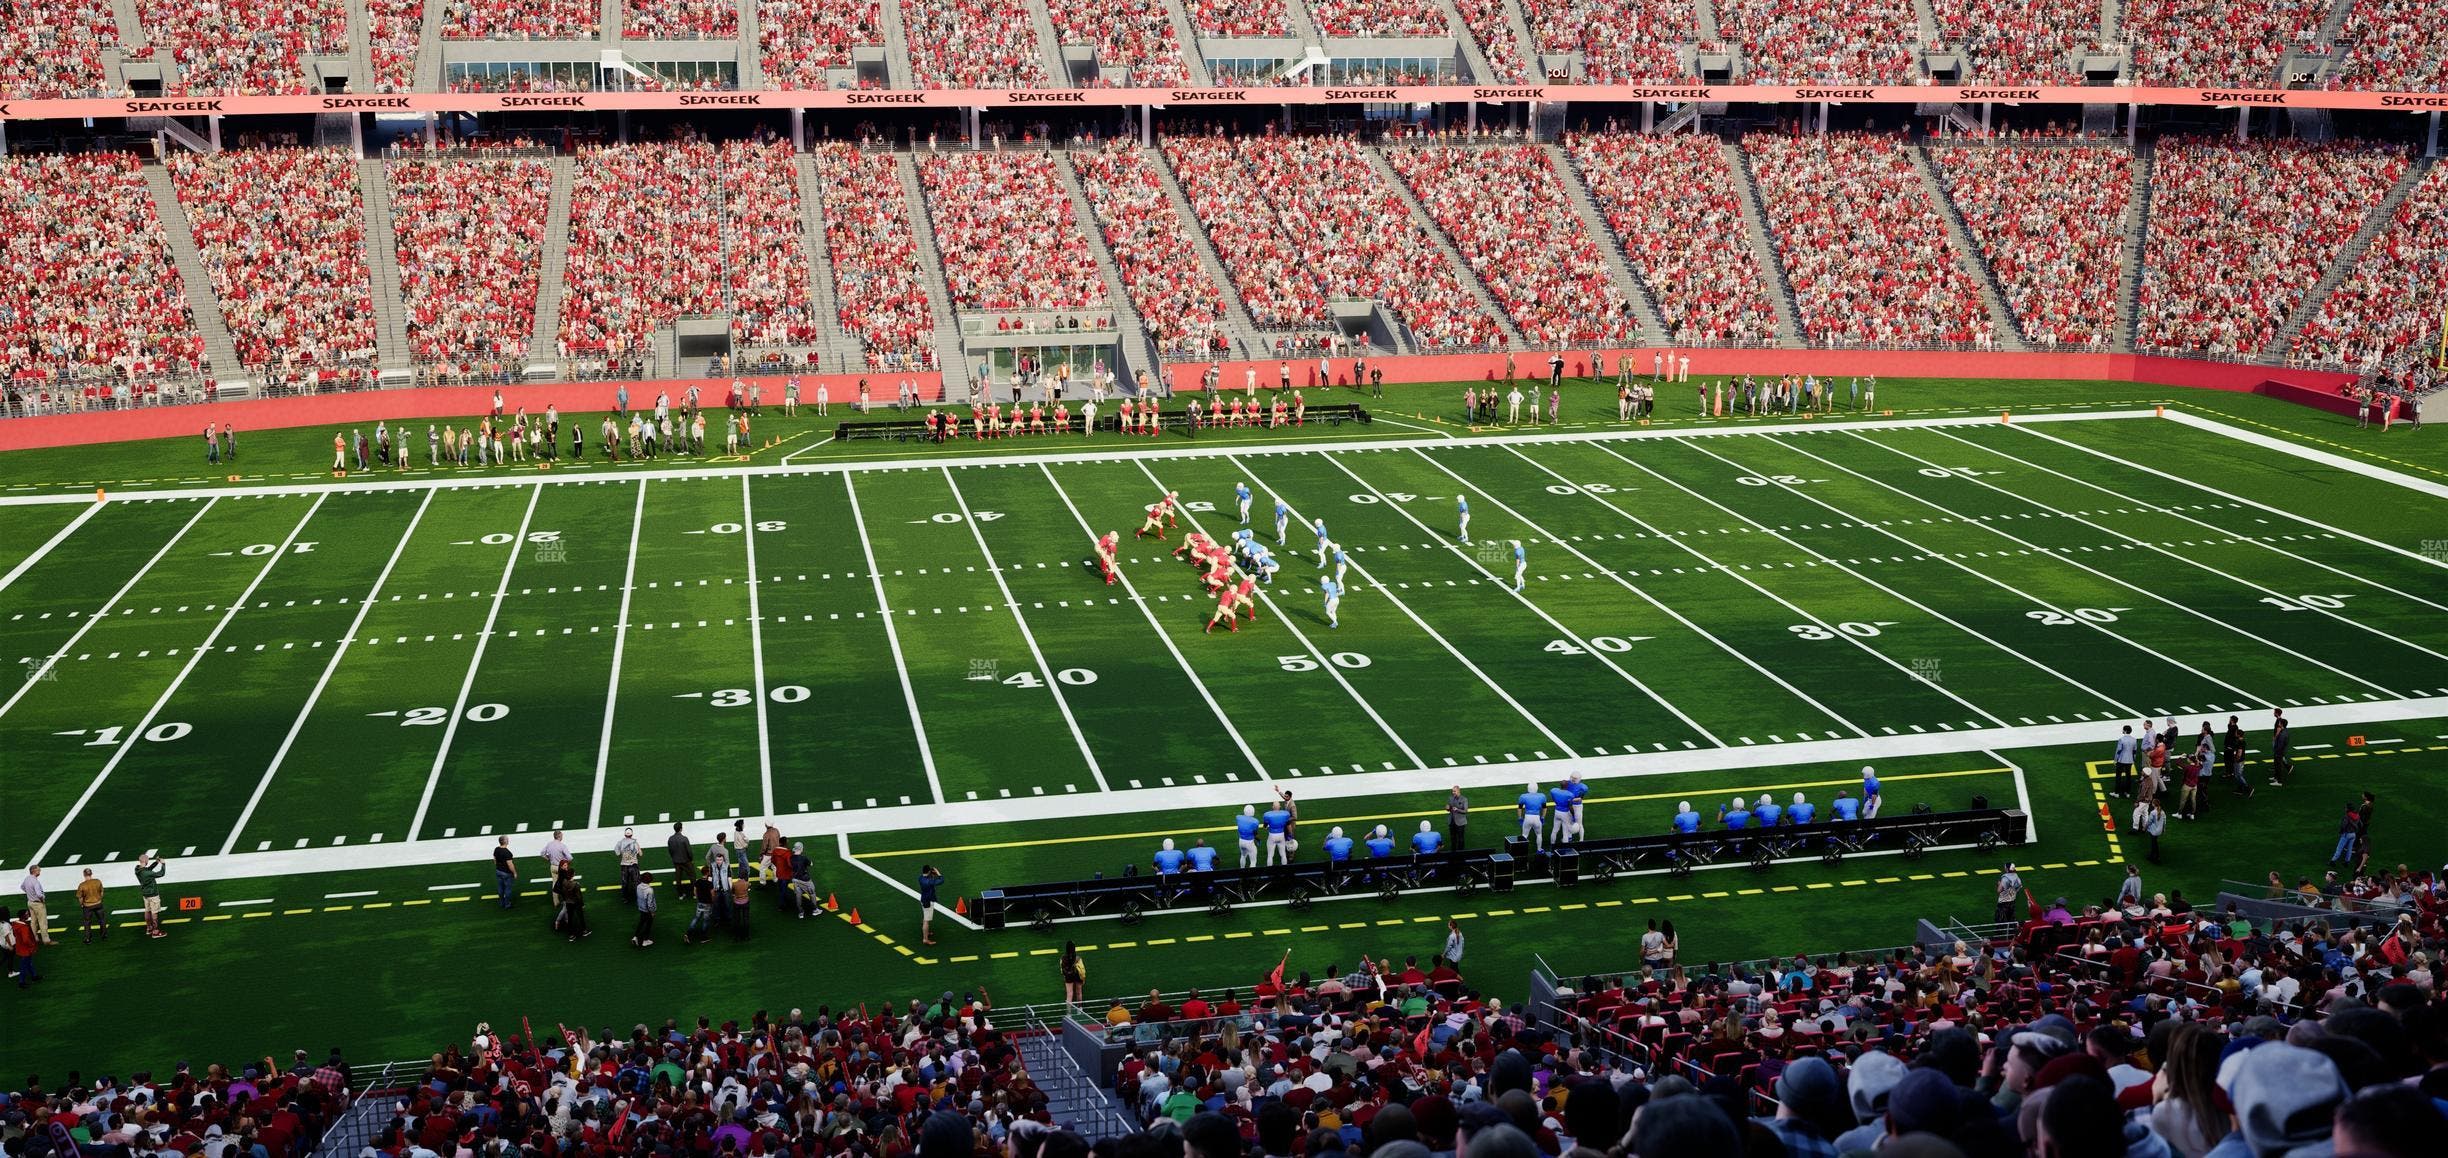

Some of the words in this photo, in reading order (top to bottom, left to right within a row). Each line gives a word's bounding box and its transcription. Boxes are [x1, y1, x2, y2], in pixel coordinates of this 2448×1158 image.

[846, 93, 925, 104] SEATGEEK
[1008, 92, 1085, 103] SEATGEEK
[1172, 91, 1246, 101] SEATGEEK
[1325, 89, 1397, 100] SEATGEEK
[1473, 88, 1544, 99] SEATGEEK
[1632, 88, 1711, 99] SEATGEEK
[1795, 89, 1874, 99] SEATGEEK
[1959, 89, 2040, 100] SEATGEEK
[2201, 91, 2286, 104] SEATGEEK
[322, 97, 410, 109] SEATGEEK
[501, 96, 584, 107] SEATGEEK
[679, 94, 761, 106] SEATGEEK
[126, 100, 223, 113] SEATGEEK
[2259, 595, 2345, 612] 10
[2025, 608, 2118, 626] 20
[1788, 622, 1881, 640] 30
[1543, 636, 1633, 655] 40
[1277, 652, 1372, 672] 50
[1002, 667, 1098, 689] 40
[710, 685, 811, 707] 30
[400, 703, 510, 727] 20
[83, 722, 193, 746] 10
[185, 899, 196, 908] 20
